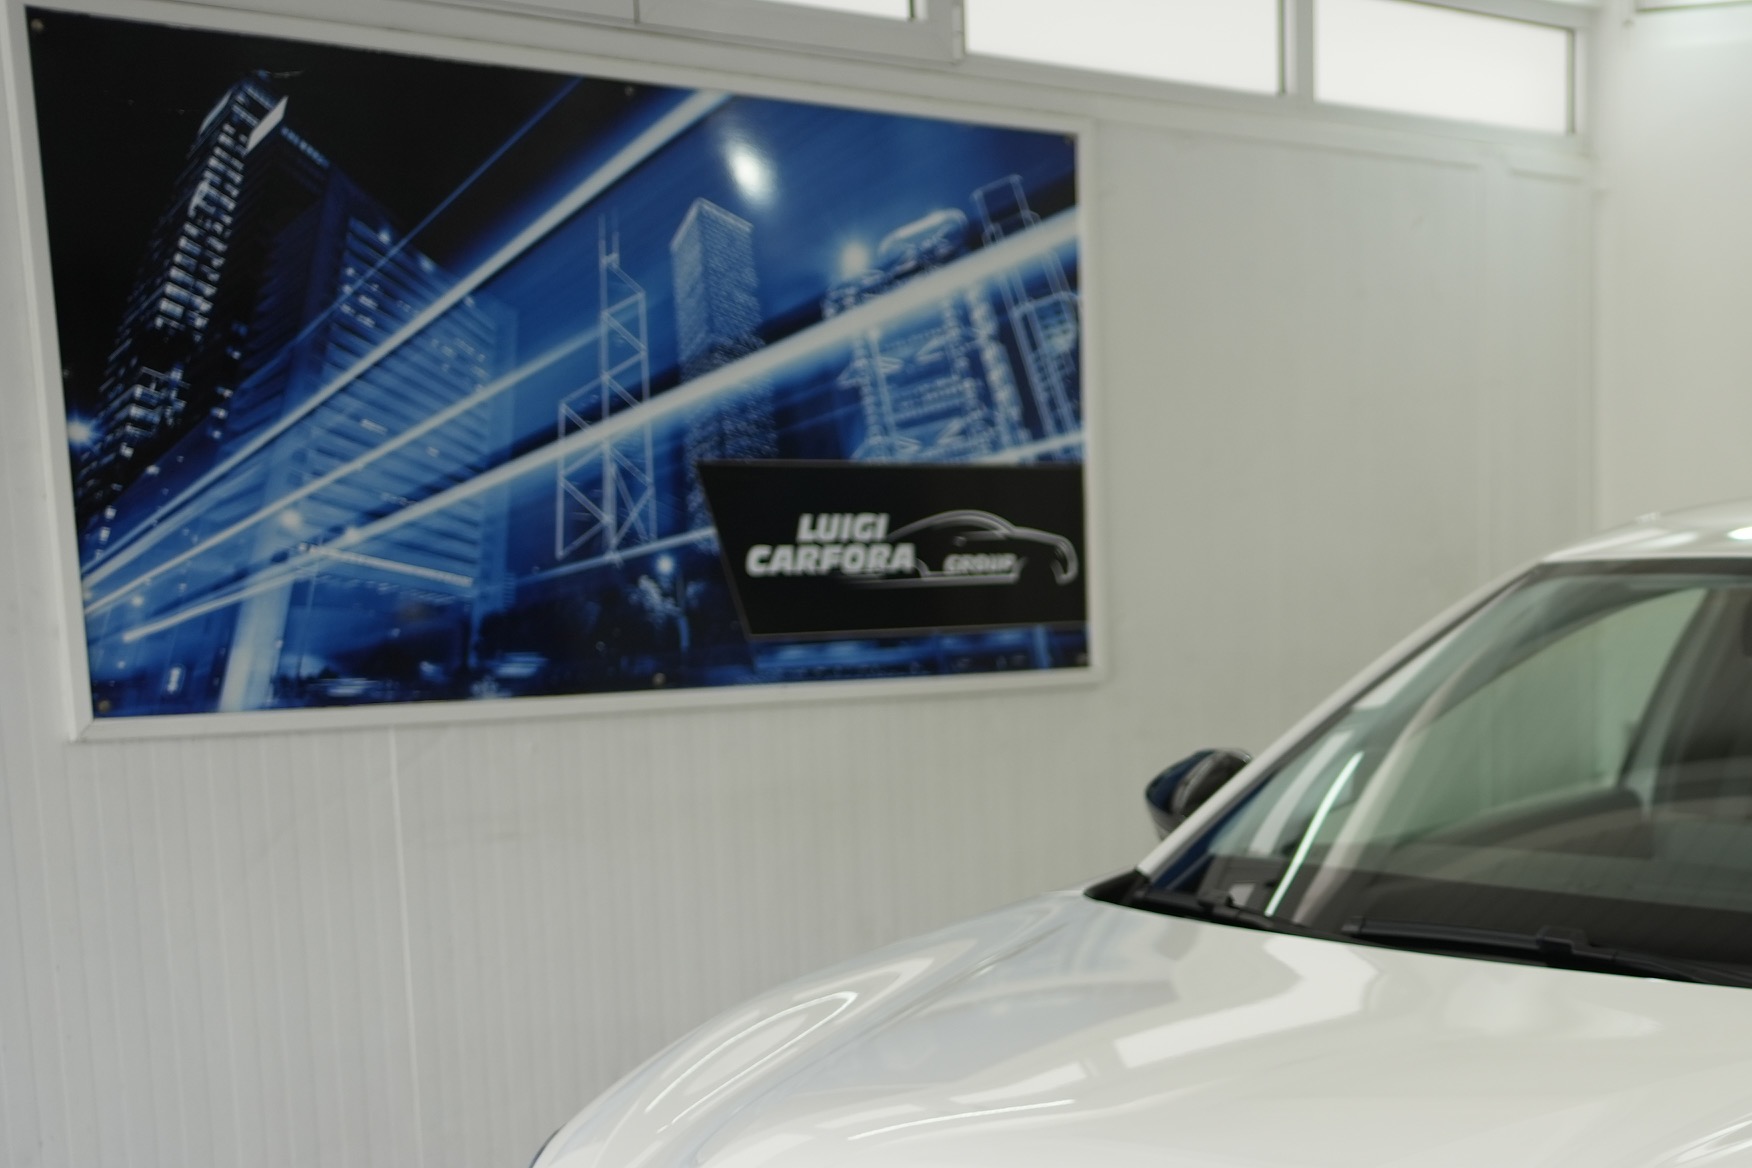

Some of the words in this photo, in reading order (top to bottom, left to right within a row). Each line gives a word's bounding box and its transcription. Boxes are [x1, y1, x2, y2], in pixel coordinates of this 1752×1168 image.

[796, 512, 890, 543] LUIGI
[745, 542, 916, 577] CARFORA
[943, 552, 1017, 576] GROUP
